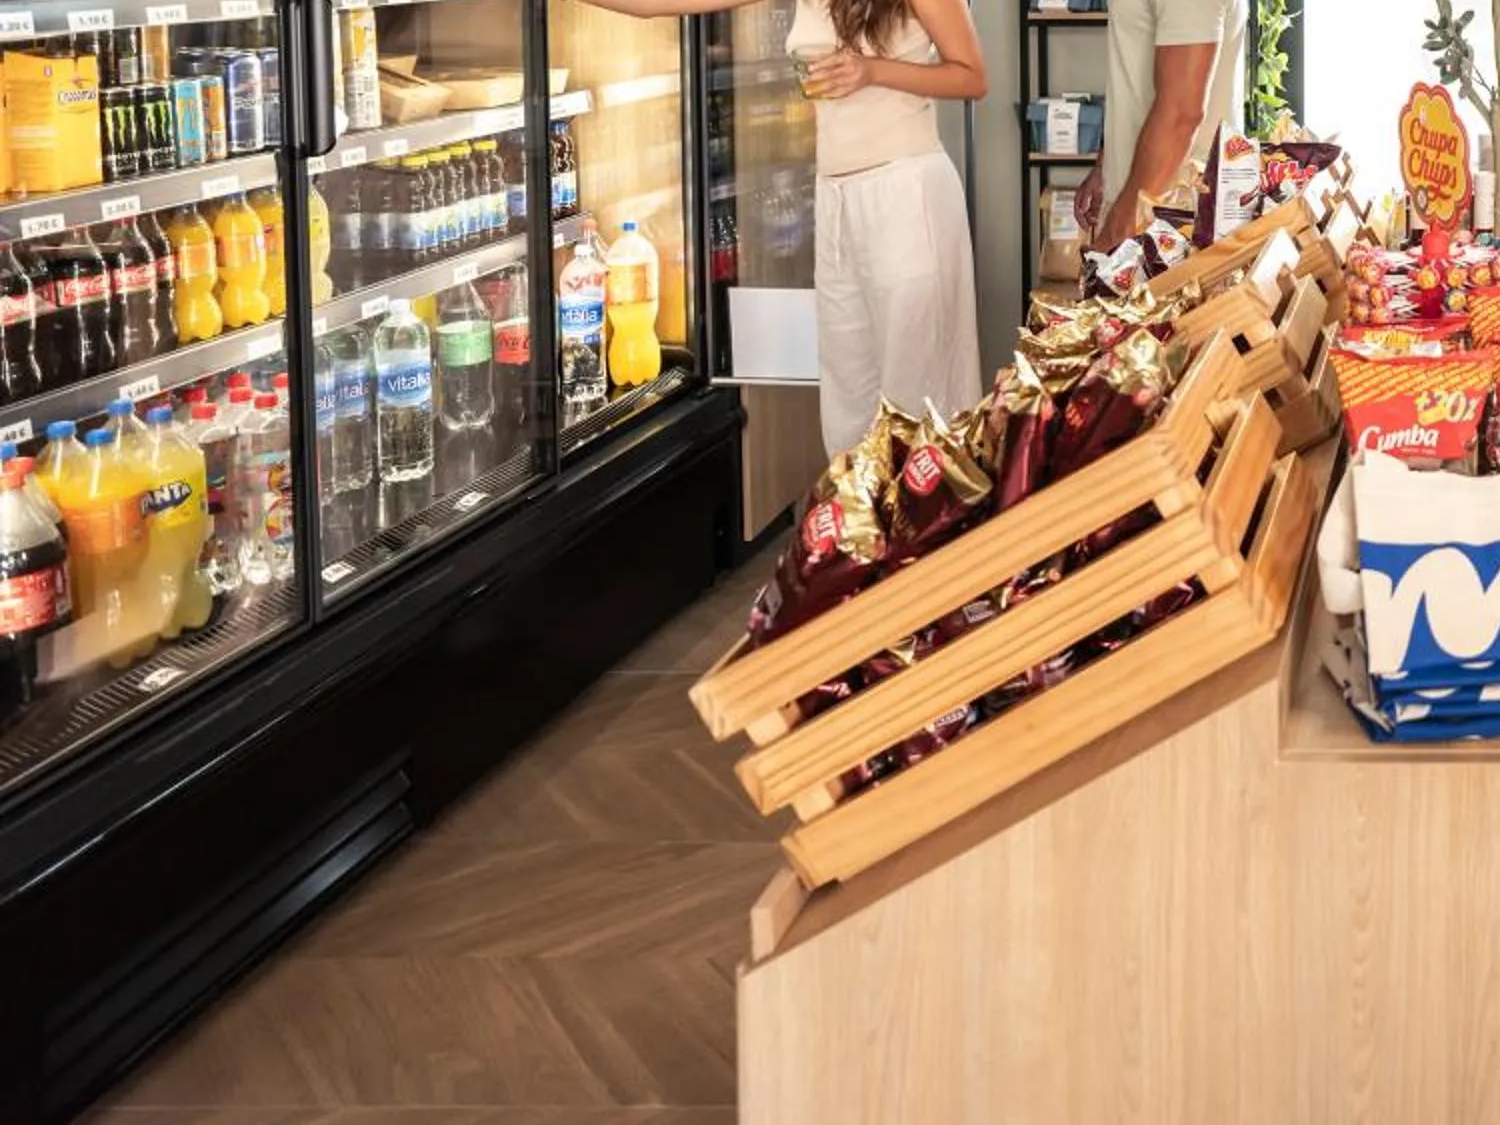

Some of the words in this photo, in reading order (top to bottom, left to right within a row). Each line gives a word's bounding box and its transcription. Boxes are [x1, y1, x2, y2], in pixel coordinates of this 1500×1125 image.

[1409, 117, 1458, 157] Chupa
[1409, 148, 1458, 193] Chups
[1359, 425, 1439, 453] Cumba
